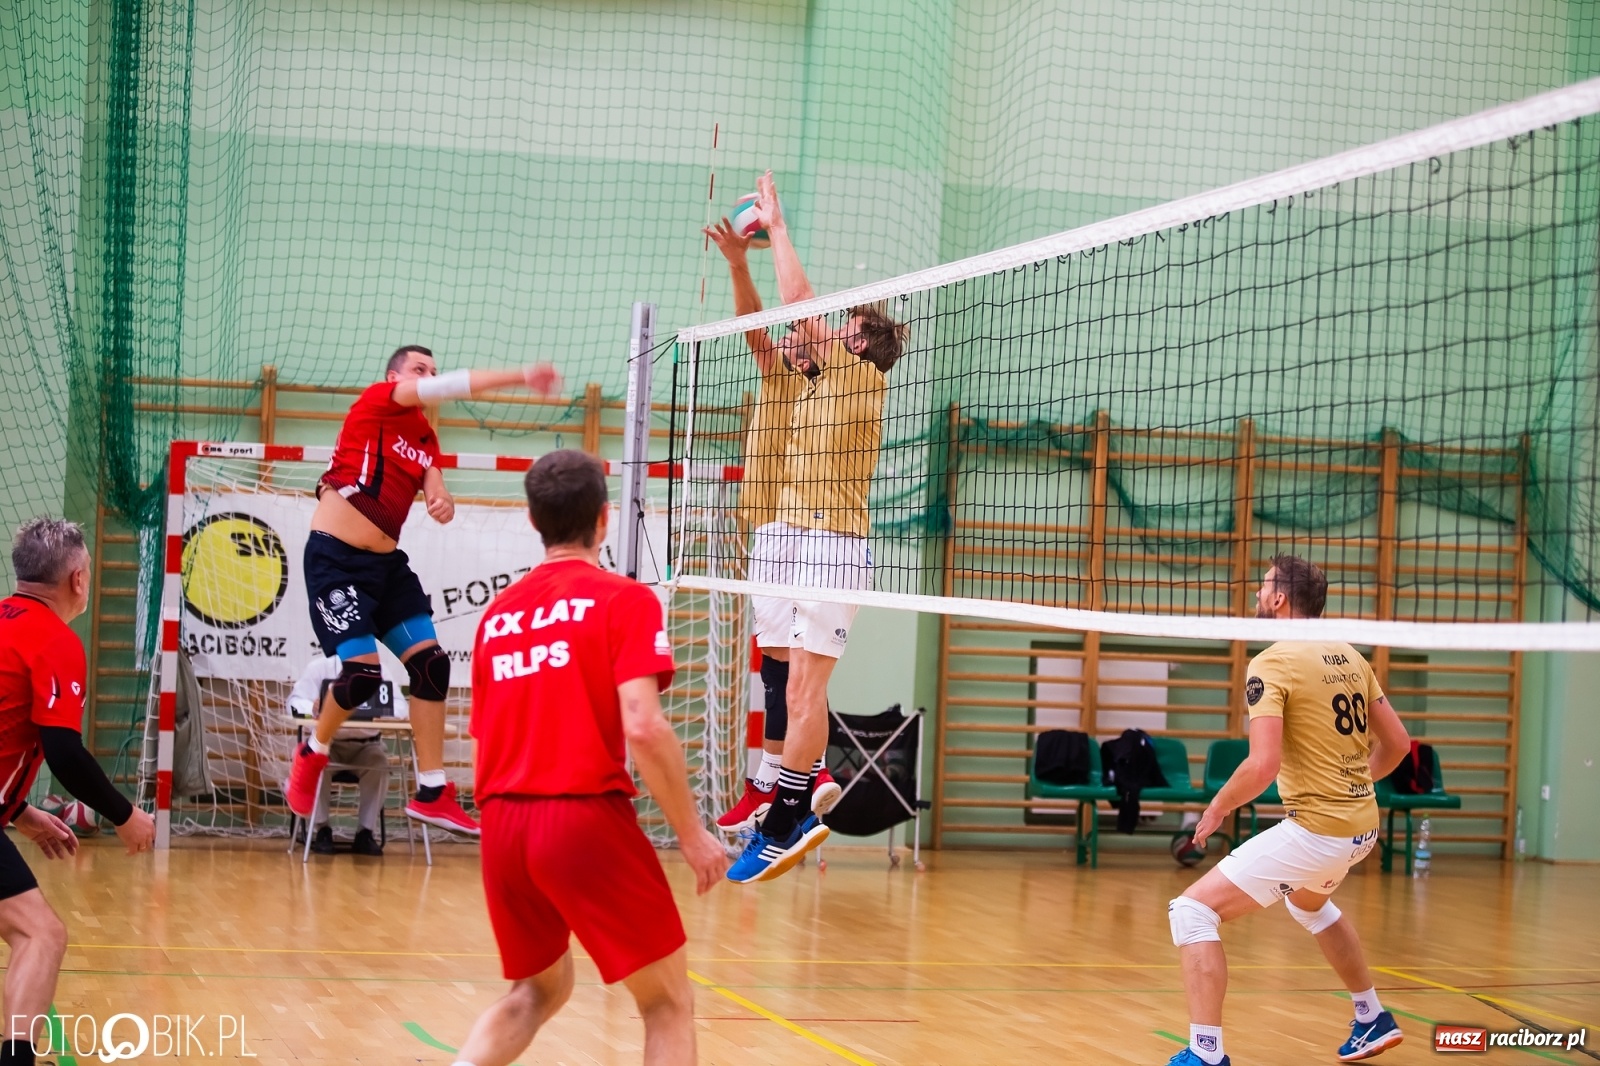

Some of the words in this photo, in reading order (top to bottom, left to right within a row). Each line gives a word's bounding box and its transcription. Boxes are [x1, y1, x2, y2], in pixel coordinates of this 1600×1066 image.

[229, 447, 254, 456] sport
[483, 611, 525, 643] XX
[531, 598, 595, 630] LAT
[184, 631, 287, 657] ACIBÓRZ
[492, 640, 570, 682] RLPS
[1322, 653, 1350, 666] KUBA
[379, 684, 389, 704] 8
[1331, 692, 1367, 736] 80
